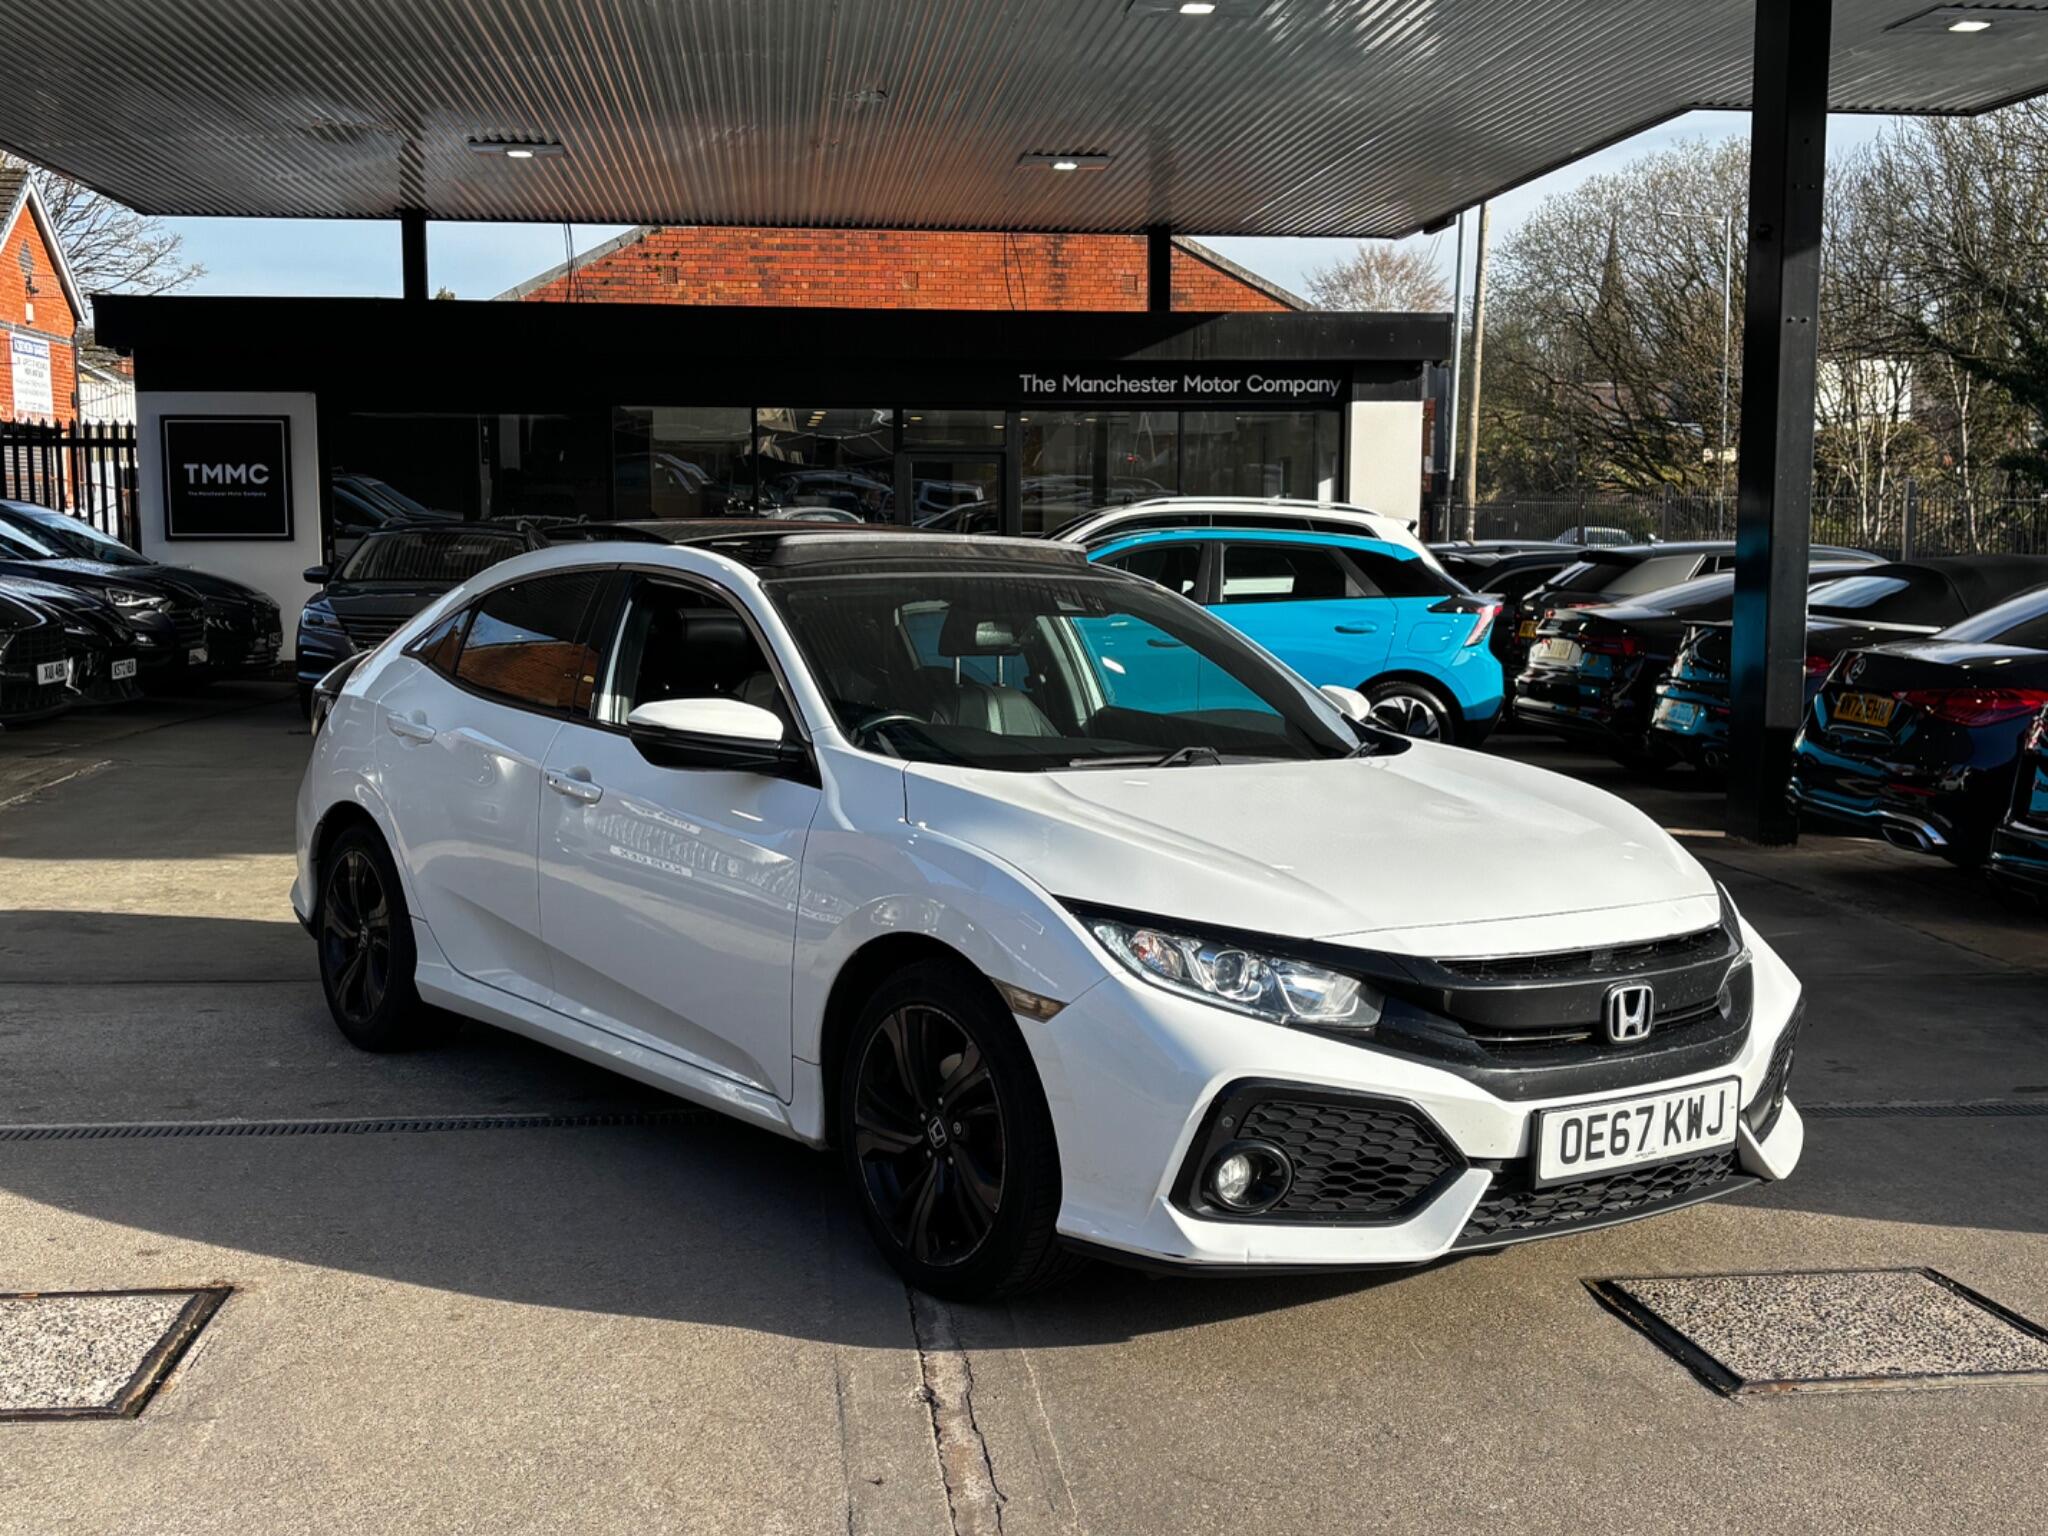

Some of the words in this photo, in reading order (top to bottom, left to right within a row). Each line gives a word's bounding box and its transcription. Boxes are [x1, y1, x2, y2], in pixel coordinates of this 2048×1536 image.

[1019, 374, 1057, 394] The
[1062, 374, 1178, 394] Manchester
[1183, 374, 1241, 394] Motor
[1246, 374, 1342, 398] Company
[183, 463, 269, 484] TMMC
[1560, 1105, 1655, 1165] OE67
[1663, 1090, 1725, 1146] KWJ
